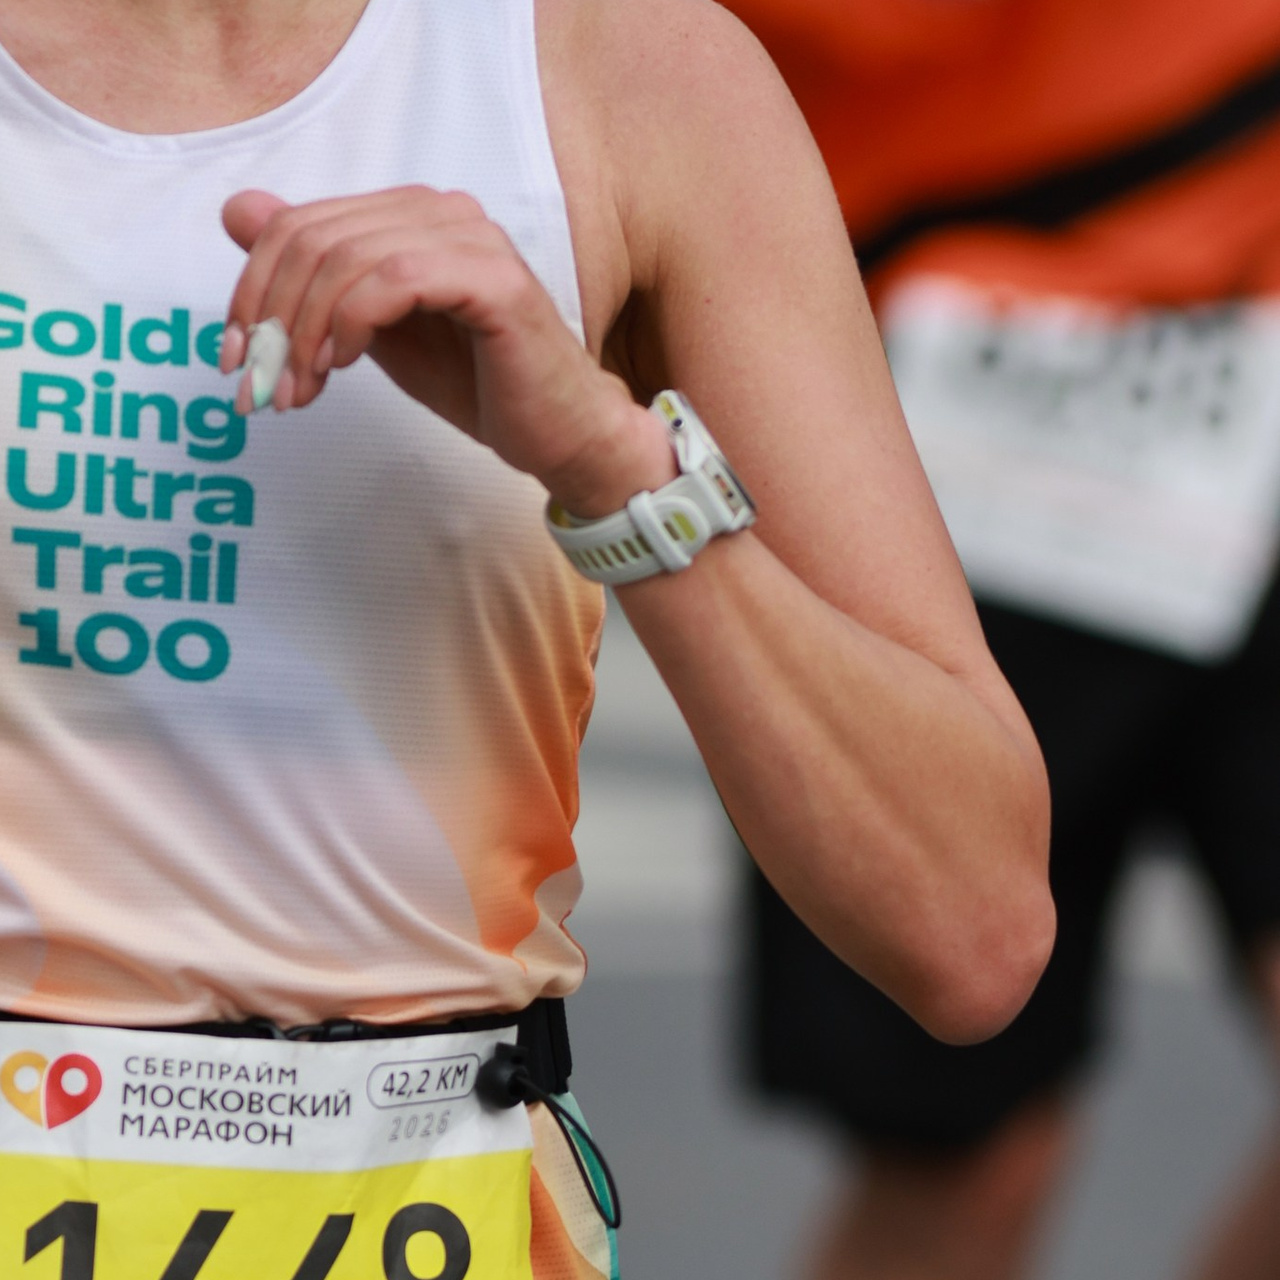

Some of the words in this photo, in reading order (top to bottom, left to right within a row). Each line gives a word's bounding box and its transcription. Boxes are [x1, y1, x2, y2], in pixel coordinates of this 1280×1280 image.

[17, 371, 248, 462] Ring
[5, 447, 256, 527] Ultra
[12, 526, 238, 605] Trail
[18, 608, 231, 683] 100
[124, 1055, 298, 1086] СБЕРПРАЙМ
[382, 1069, 430, 1099] 42,2
[122, 1082, 351, 1117] МОСКОВСКИЙ
[120, 1113, 293, 1147] МАРАФОН
[388, 1109, 451, 1143] 2026
